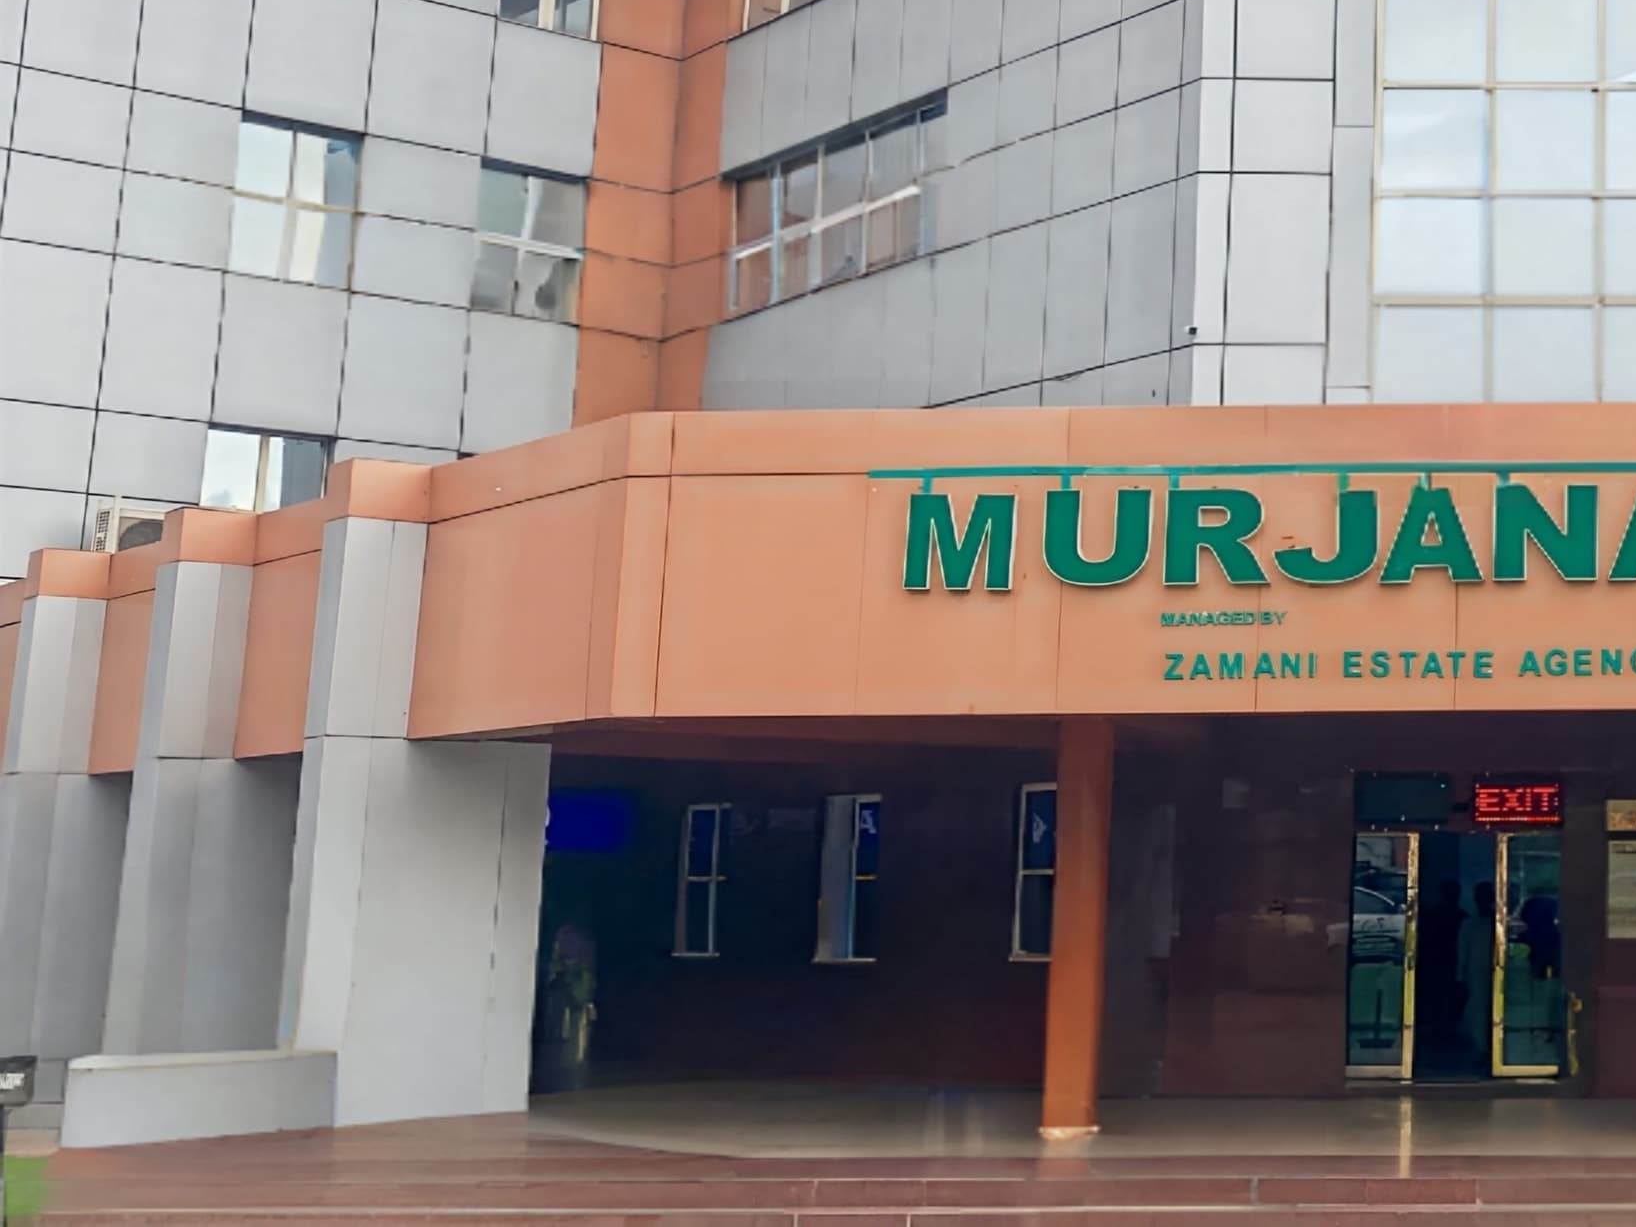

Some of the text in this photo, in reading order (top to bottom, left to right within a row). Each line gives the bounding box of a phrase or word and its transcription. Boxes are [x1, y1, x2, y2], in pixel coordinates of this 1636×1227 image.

[1160, 611, 1288, 627] MANAGED BY
[1163, 651, 1318, 681] ZAMANI
[1342, 649, 1495, 680] ESTATE
[1478, 787, 1558, 812] EXIT
